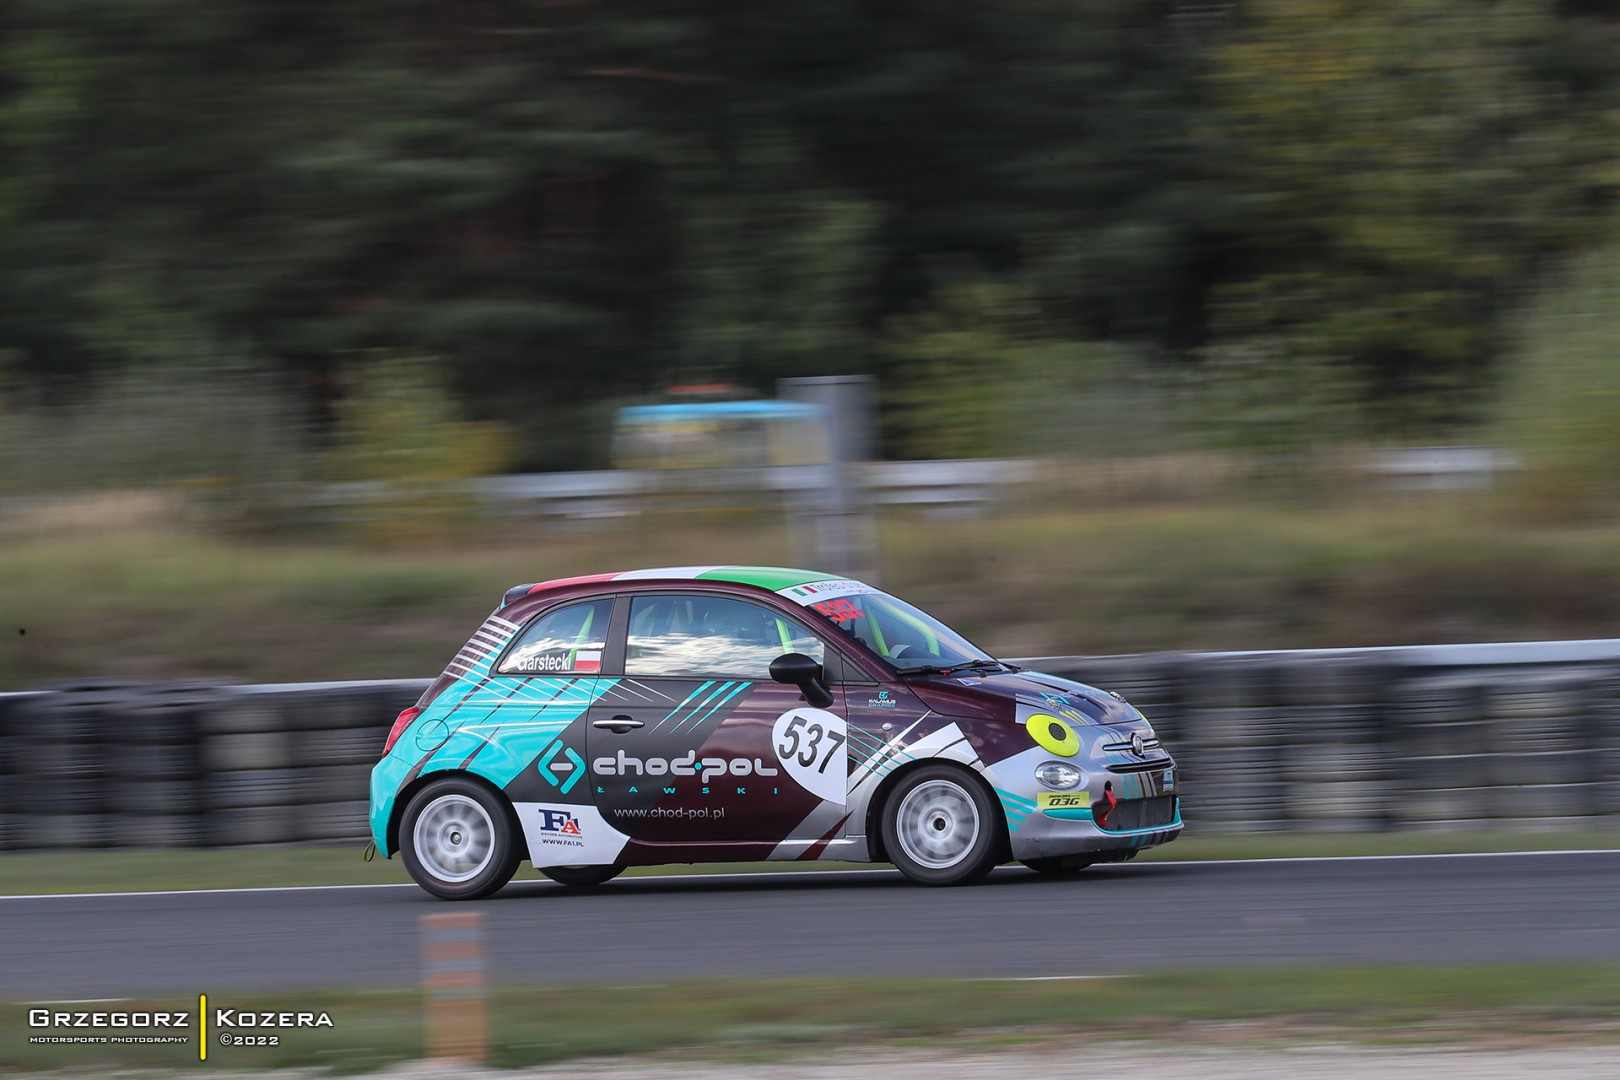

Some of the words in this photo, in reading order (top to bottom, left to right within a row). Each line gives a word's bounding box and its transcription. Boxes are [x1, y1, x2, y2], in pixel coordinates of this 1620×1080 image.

[813, 599, 866, 622] 537
[778, 715, 846, 774] 537
[597, 786, 778, 795] ŁAWSKI
[614, 807, 725, 820] www.chod-pol.pl
[541, 839, 585, 847] WWW.FA1.PL
